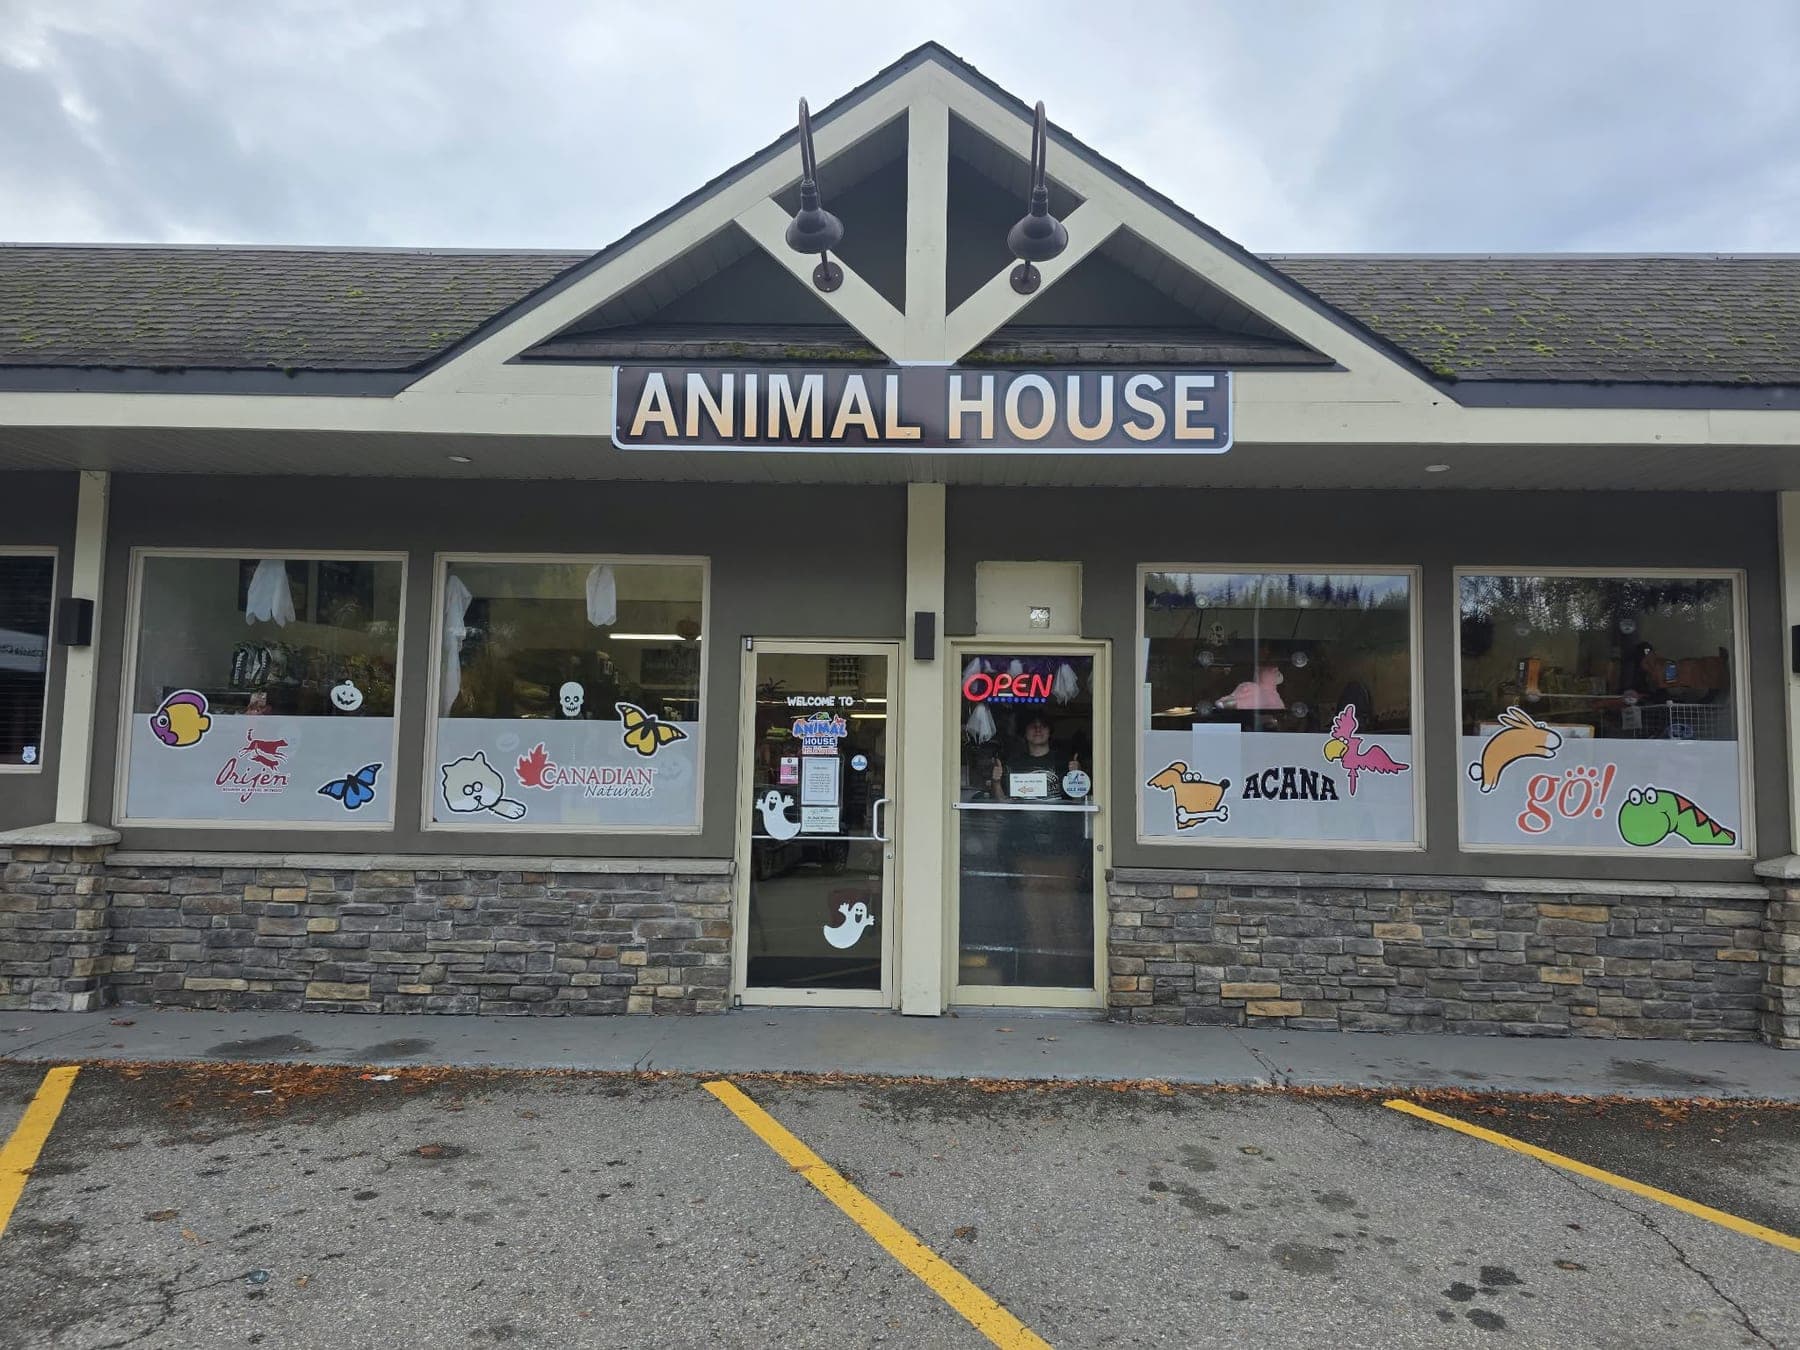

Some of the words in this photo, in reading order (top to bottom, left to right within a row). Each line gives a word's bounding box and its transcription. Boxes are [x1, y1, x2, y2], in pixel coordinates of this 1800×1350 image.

[629, 371, 922, 440] ANIMAL
[948, 373, 1217, 442] HOUSE
[963, 672, 1054, 701] OPEN
[786, 695, 836, 707] WELCOME
[838, 696, 854, 707] TO
[793, 719, 848, 738] ANIMAL
[804, 737, 836, 746] HOUSE
[215, 757, 288, 803] Orijen
[541, 763, 654, 789] CANADIAN
[1242, 766, 1340, 801] ACANA
[584, 782, 655, 798] Naturals
